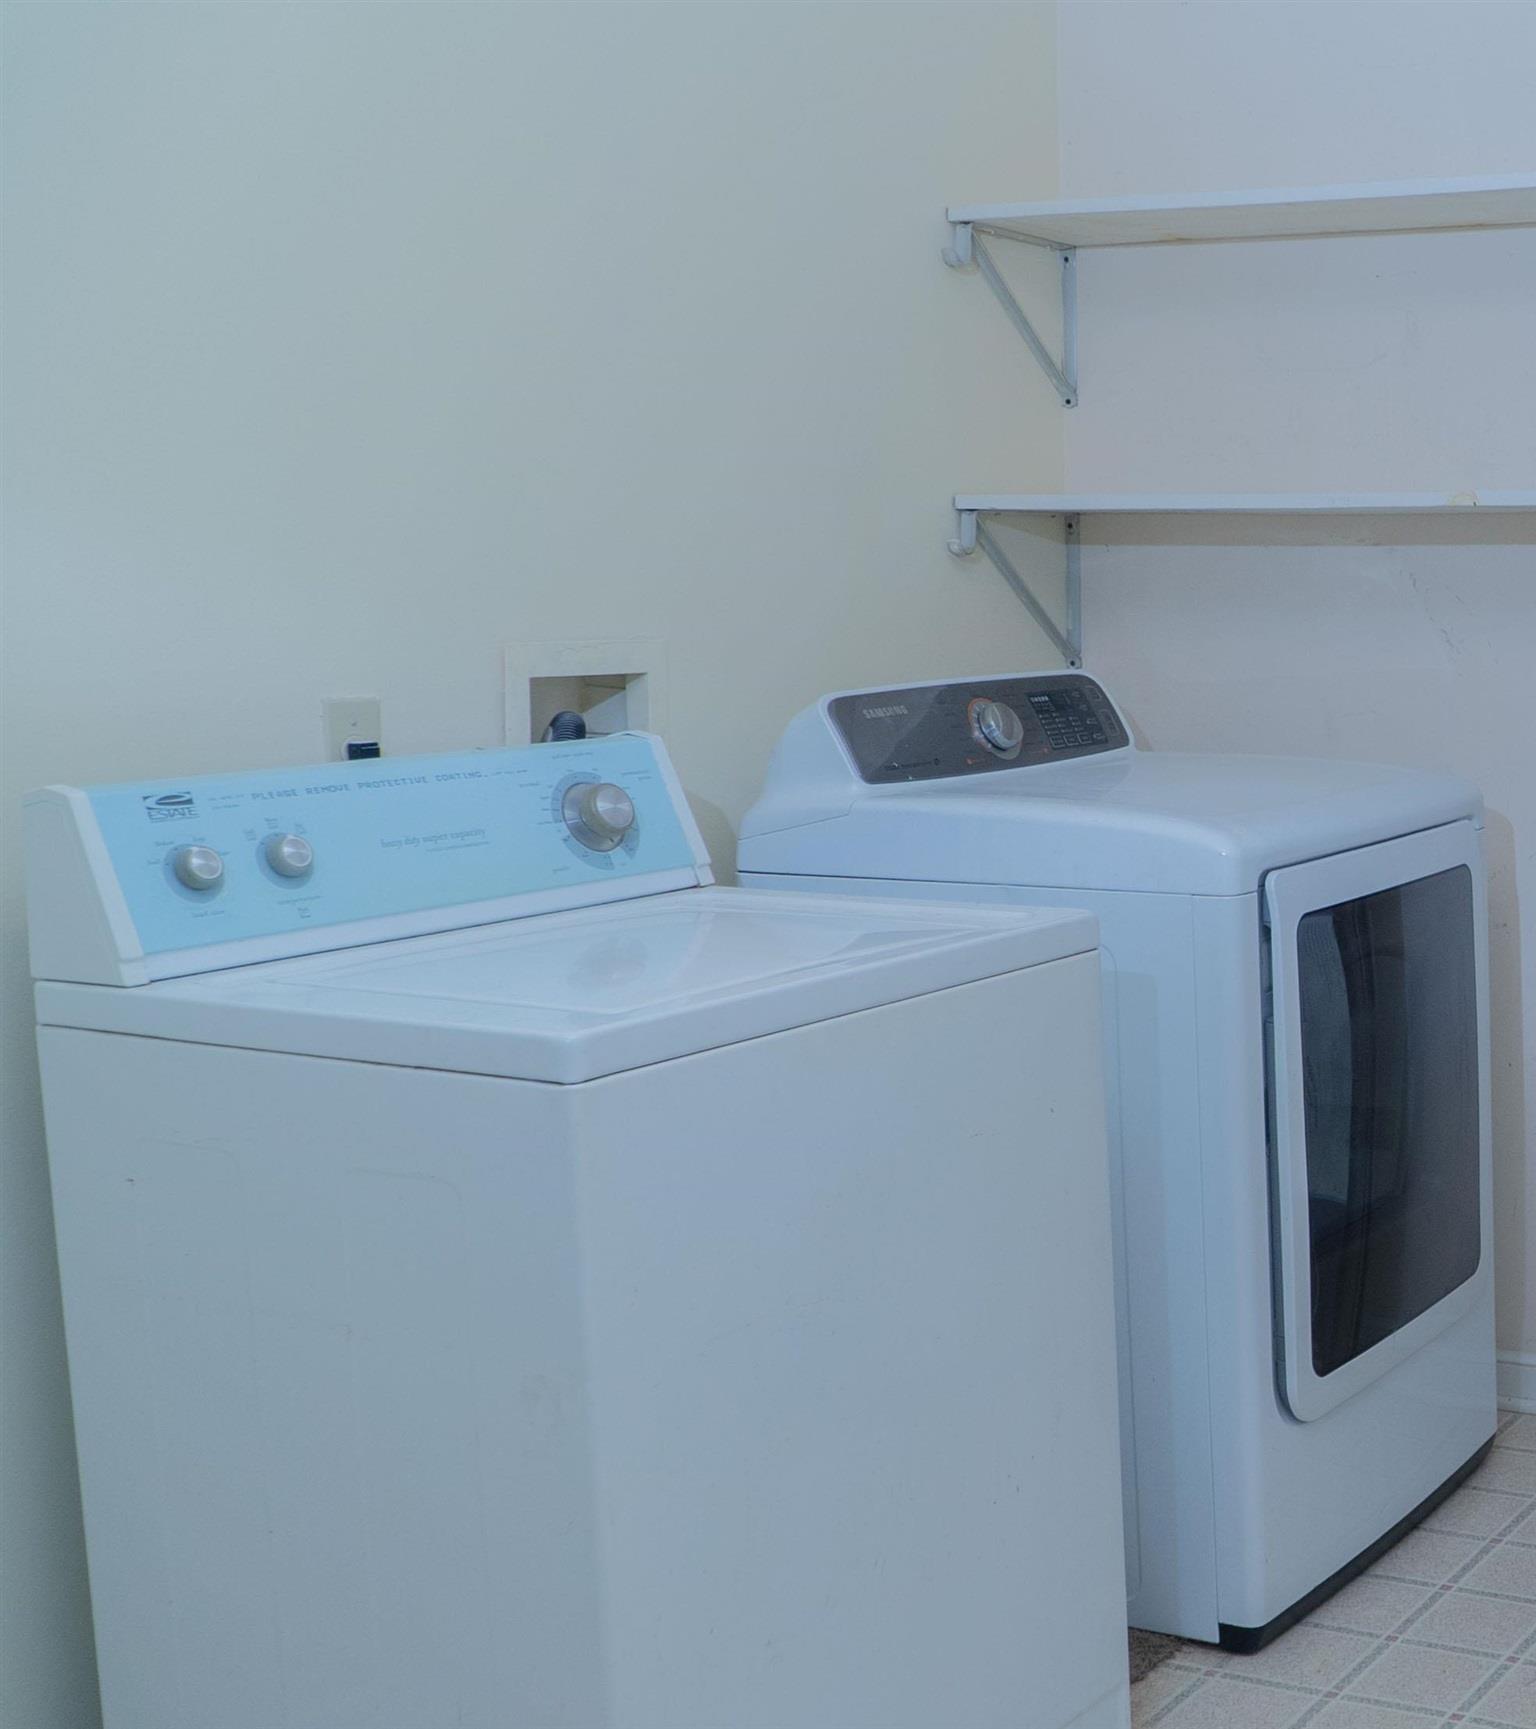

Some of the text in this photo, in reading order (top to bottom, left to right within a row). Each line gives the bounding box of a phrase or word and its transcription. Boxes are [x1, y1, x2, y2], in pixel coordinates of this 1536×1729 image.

[863, 704, 908, 719] SAMSUNG
[251, 788, 298, 801] PLEASE
[304, 782, 351, 795] REMOVE
[357, 776, 427, 789] PROTECTIVE
[147, 807, 199, 821] ESTATE
[422, 833, 448, 845] super
[450, 828, 485, 841] capacity
